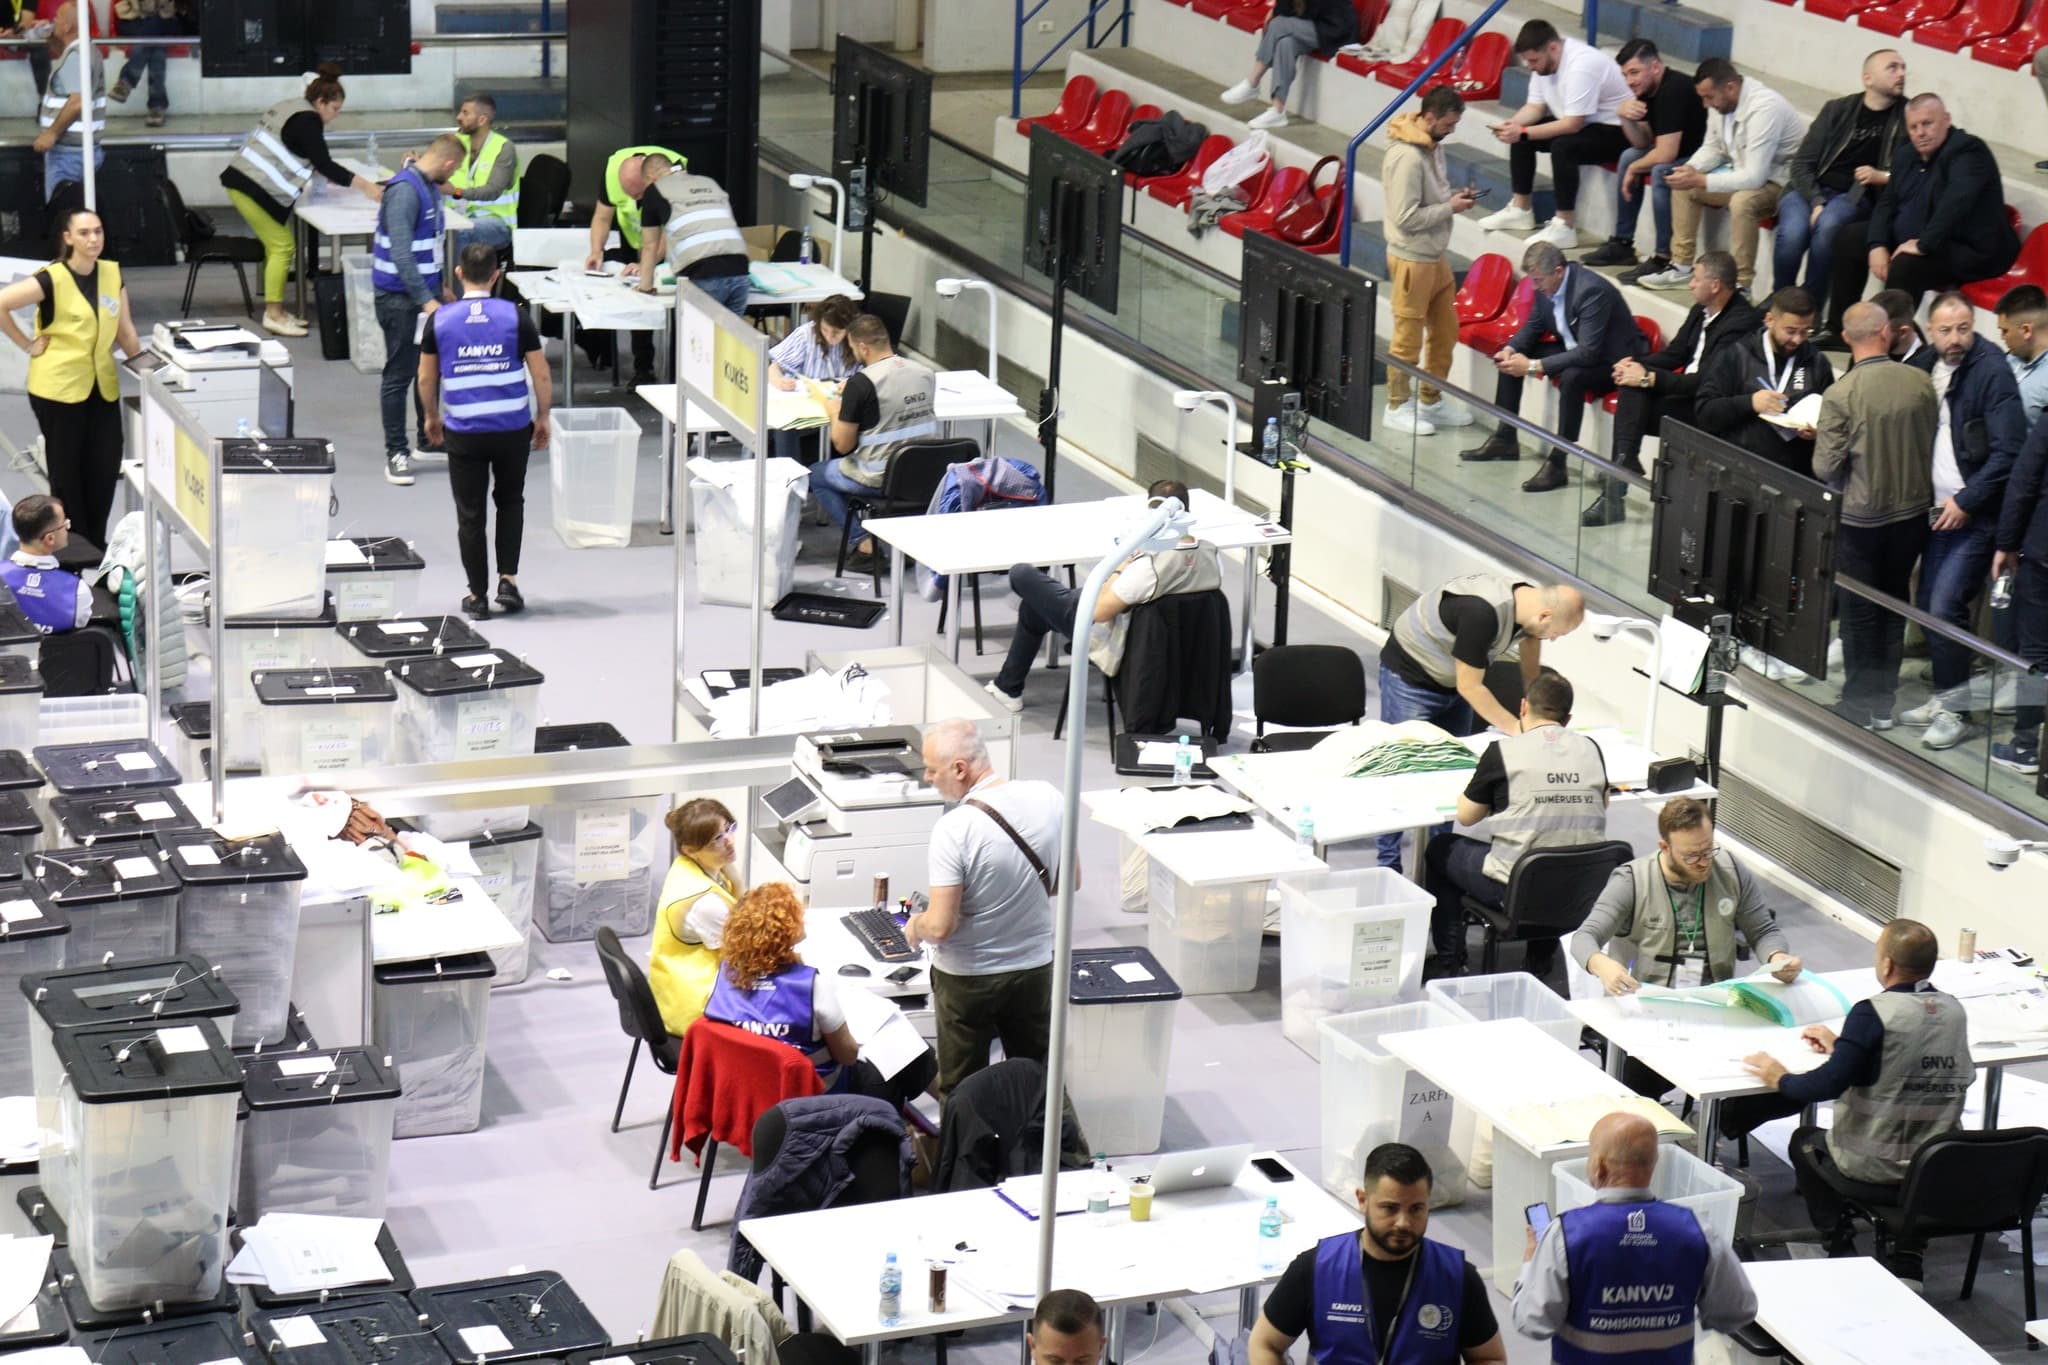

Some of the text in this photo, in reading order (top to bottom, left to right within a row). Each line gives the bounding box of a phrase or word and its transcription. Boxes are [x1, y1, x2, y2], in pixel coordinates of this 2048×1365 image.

[458, 344, 503, 358] KANVVJ
[723, 359, 749, 395] KUKËS
[182, 463, 206, 505] VLORË
[1546, 772, 1580, 784] GNVJ
[1921, 1055, 1955, 1070] GNVJ
[1422, 1111, 1433, 1124] A
[1602, 1284, 1675, 1304] KANVVJ
[1590, 1313, 1681, 1331] KOMISIONER VJ
